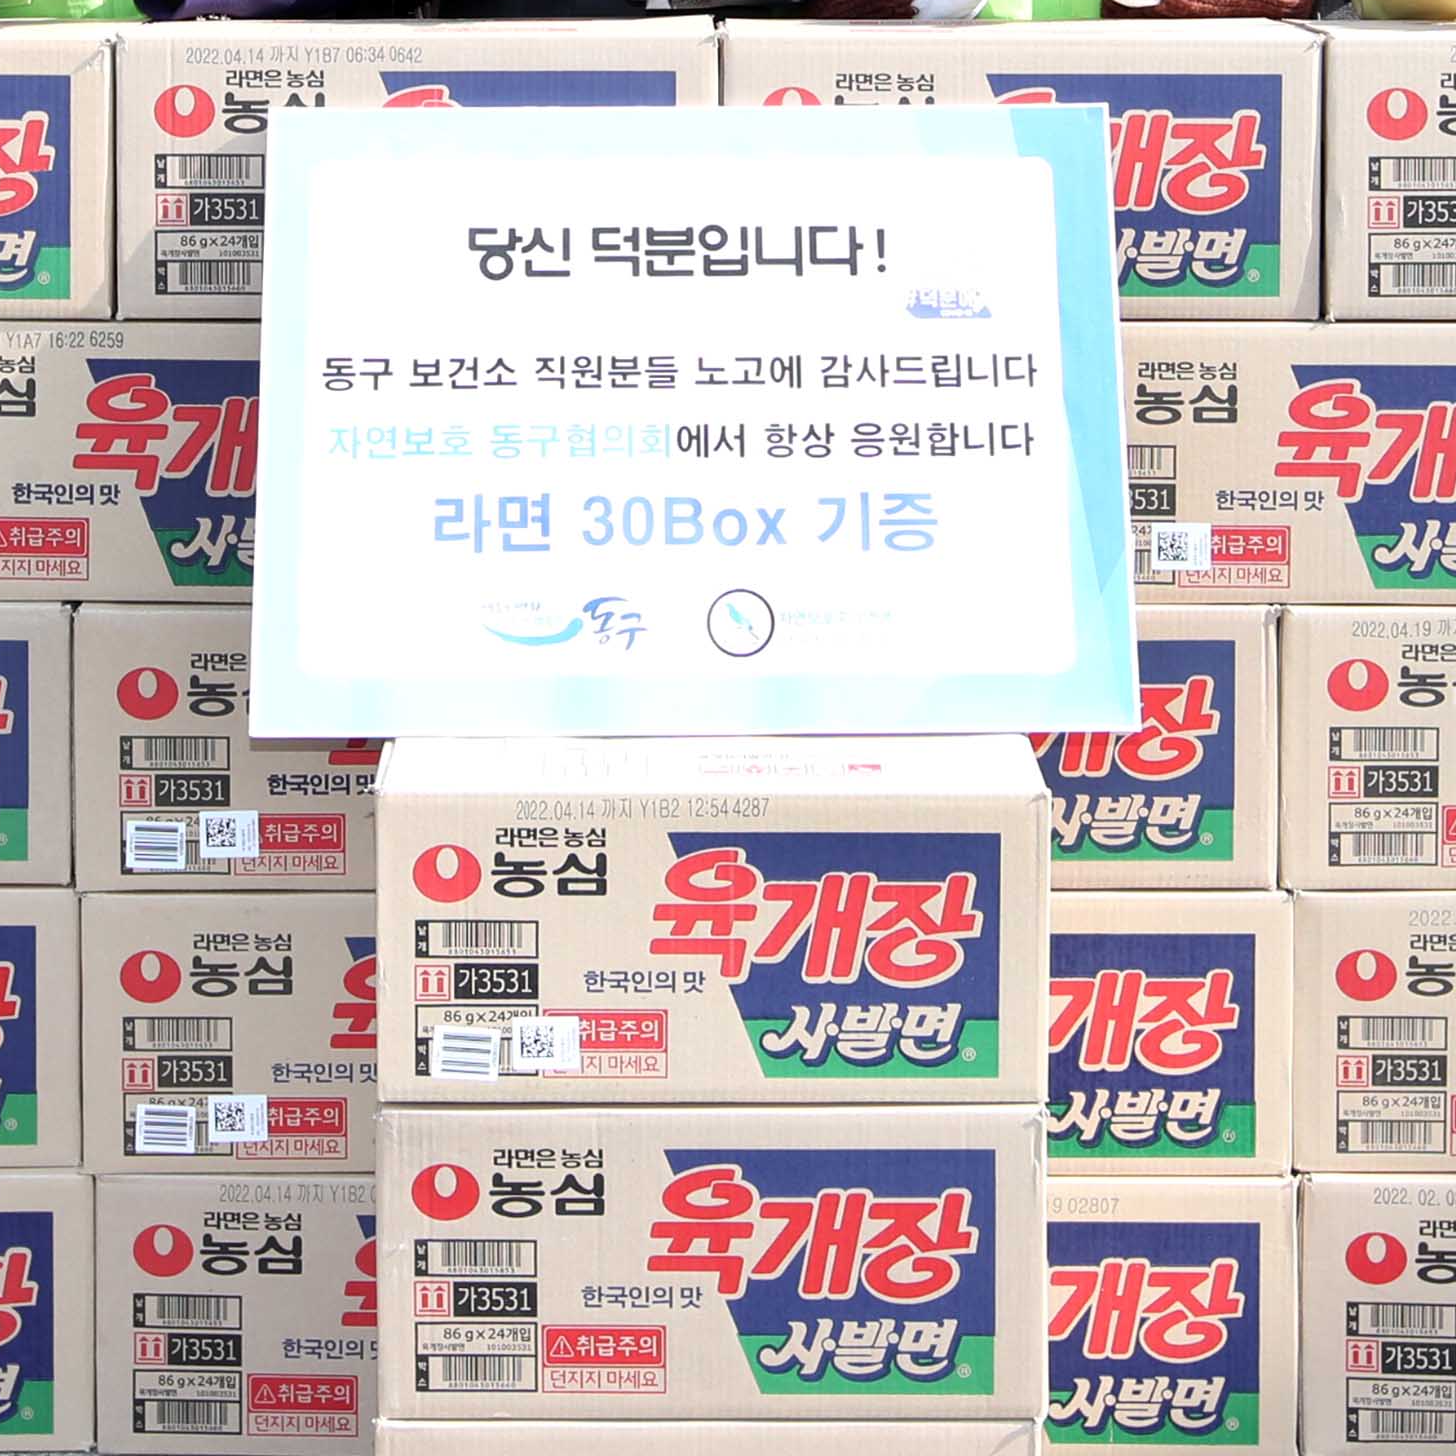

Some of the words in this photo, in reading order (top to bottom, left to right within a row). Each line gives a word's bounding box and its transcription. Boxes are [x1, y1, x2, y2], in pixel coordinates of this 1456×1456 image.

[186, 48, 263, 65] 2022.04.14
[346, 47, 384, 63] 06:34
[194, 197, 260, 222] 가3531
[469, 228, 570, 280] 당신
[323, 358, 392, 391] 동구
[410, 358, 516, 389] 보건소
[536, 356, 678, 389] 직원분들
[696, 355, 801, 388] 노고에
[822, 354, 1036, 388] 감사드립니다
[72, 373, 257, 499] 육개
[330, 426, 472, 459] 자연보호
[766, 424, 834, 458] 항상
[852, 423, 1033, 457] 응원합니다
[435, 493, 550, 553] 라면
[583, 496, 786, 546] 30Box
[818, 492, 937, 551] 기증
[517, 800, 594, 821] 2022.04.14
[688, 798, 728, 817] 12:54
[733, 796, 768, 817] 4287
[491, 853, 608, 898] 농심
[649, 847, 979, 983] 육개장
[189, 956, 293, 997] 농심
[761, 1003, 962, 1062] 사발면
[1049, 954, 1239, 1072] 개장
[1043, 1089, 1221, 1142] 사발면
[493, 1149, 555, 1169] 라면은
[561, 1149, 604, 1169] 농심
[489, 1173, 605, 1217] 농심
[647, 1167, 974, 1299] 육개장
[200, 1234, 304, 1276] 농심
[458, 1286, 532, 1313] 가3531
[581, 1286, 674, 1310] 한국인의
[679, 1286, 704, 1310] 맛
[575, 1334, 657, 1358] 취급주의
[759, 1319, 958, 1376] 사발면
[550, 1369, 600, 1390] 던지지
[608, 1369, 658, 1390] 마세요
[1047, 1376, 1226, 1429] 사발면
